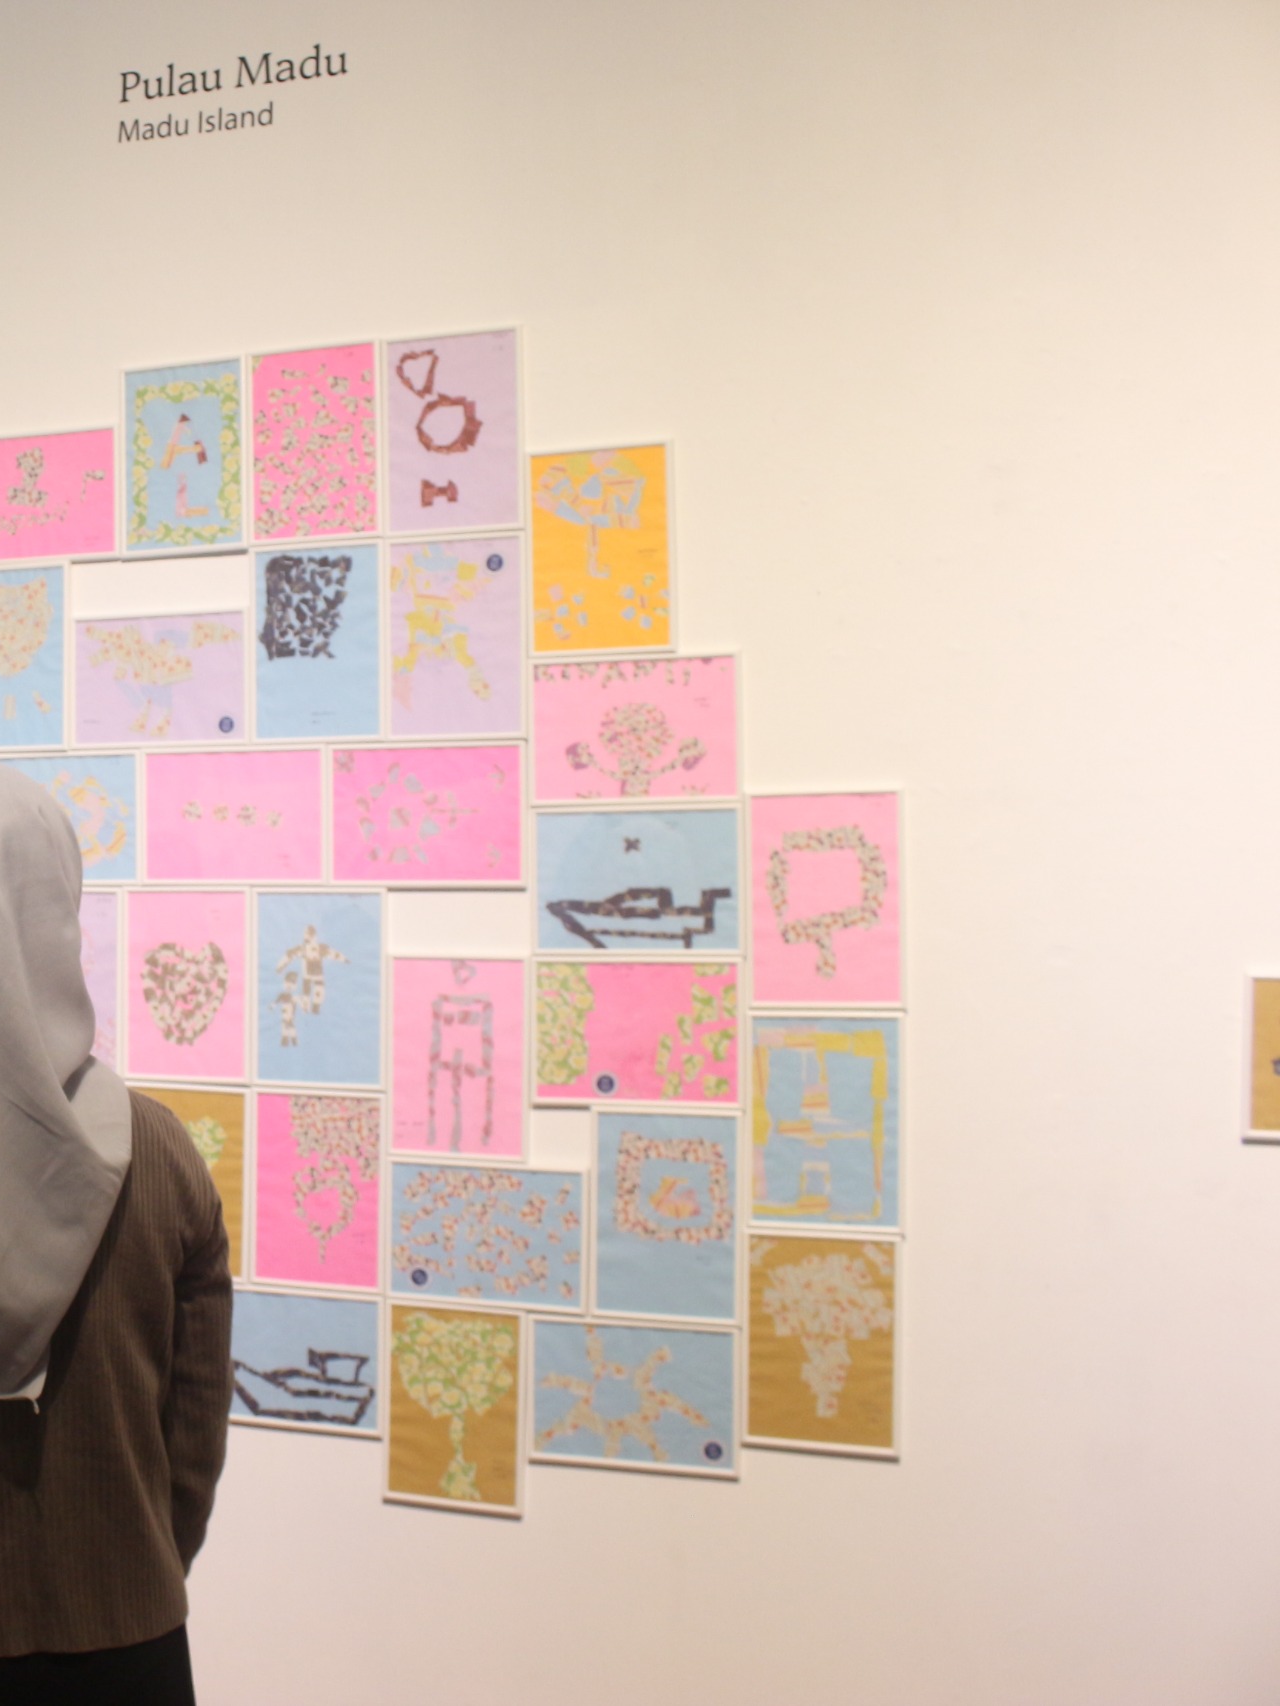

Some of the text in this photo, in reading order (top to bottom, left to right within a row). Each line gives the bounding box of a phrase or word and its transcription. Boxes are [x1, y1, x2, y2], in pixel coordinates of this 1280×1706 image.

[119, 43, 348, 104] Pulau Madu
[118, 101, 274, 143] Madu Island
